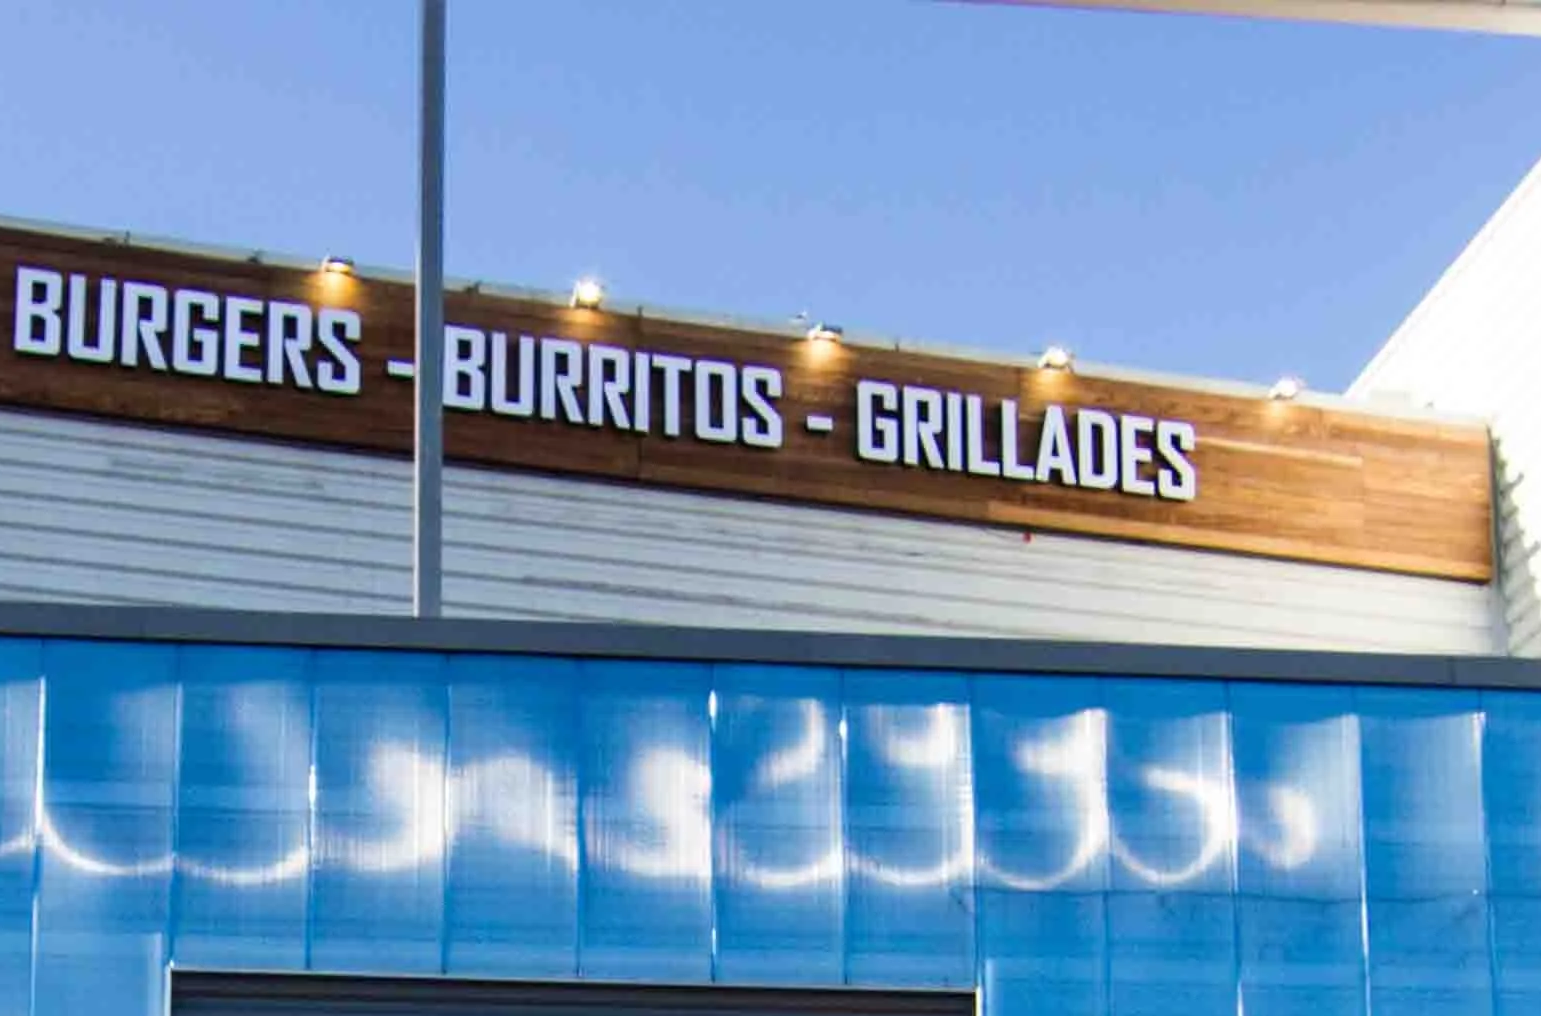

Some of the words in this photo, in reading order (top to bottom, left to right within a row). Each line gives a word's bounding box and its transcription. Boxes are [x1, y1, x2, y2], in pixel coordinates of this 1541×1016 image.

[14, 264, 361, 396] BURGERS
[442, 324, 783, 448] BURRITOS
[857, 380, 1196, 501] GRILLADES
